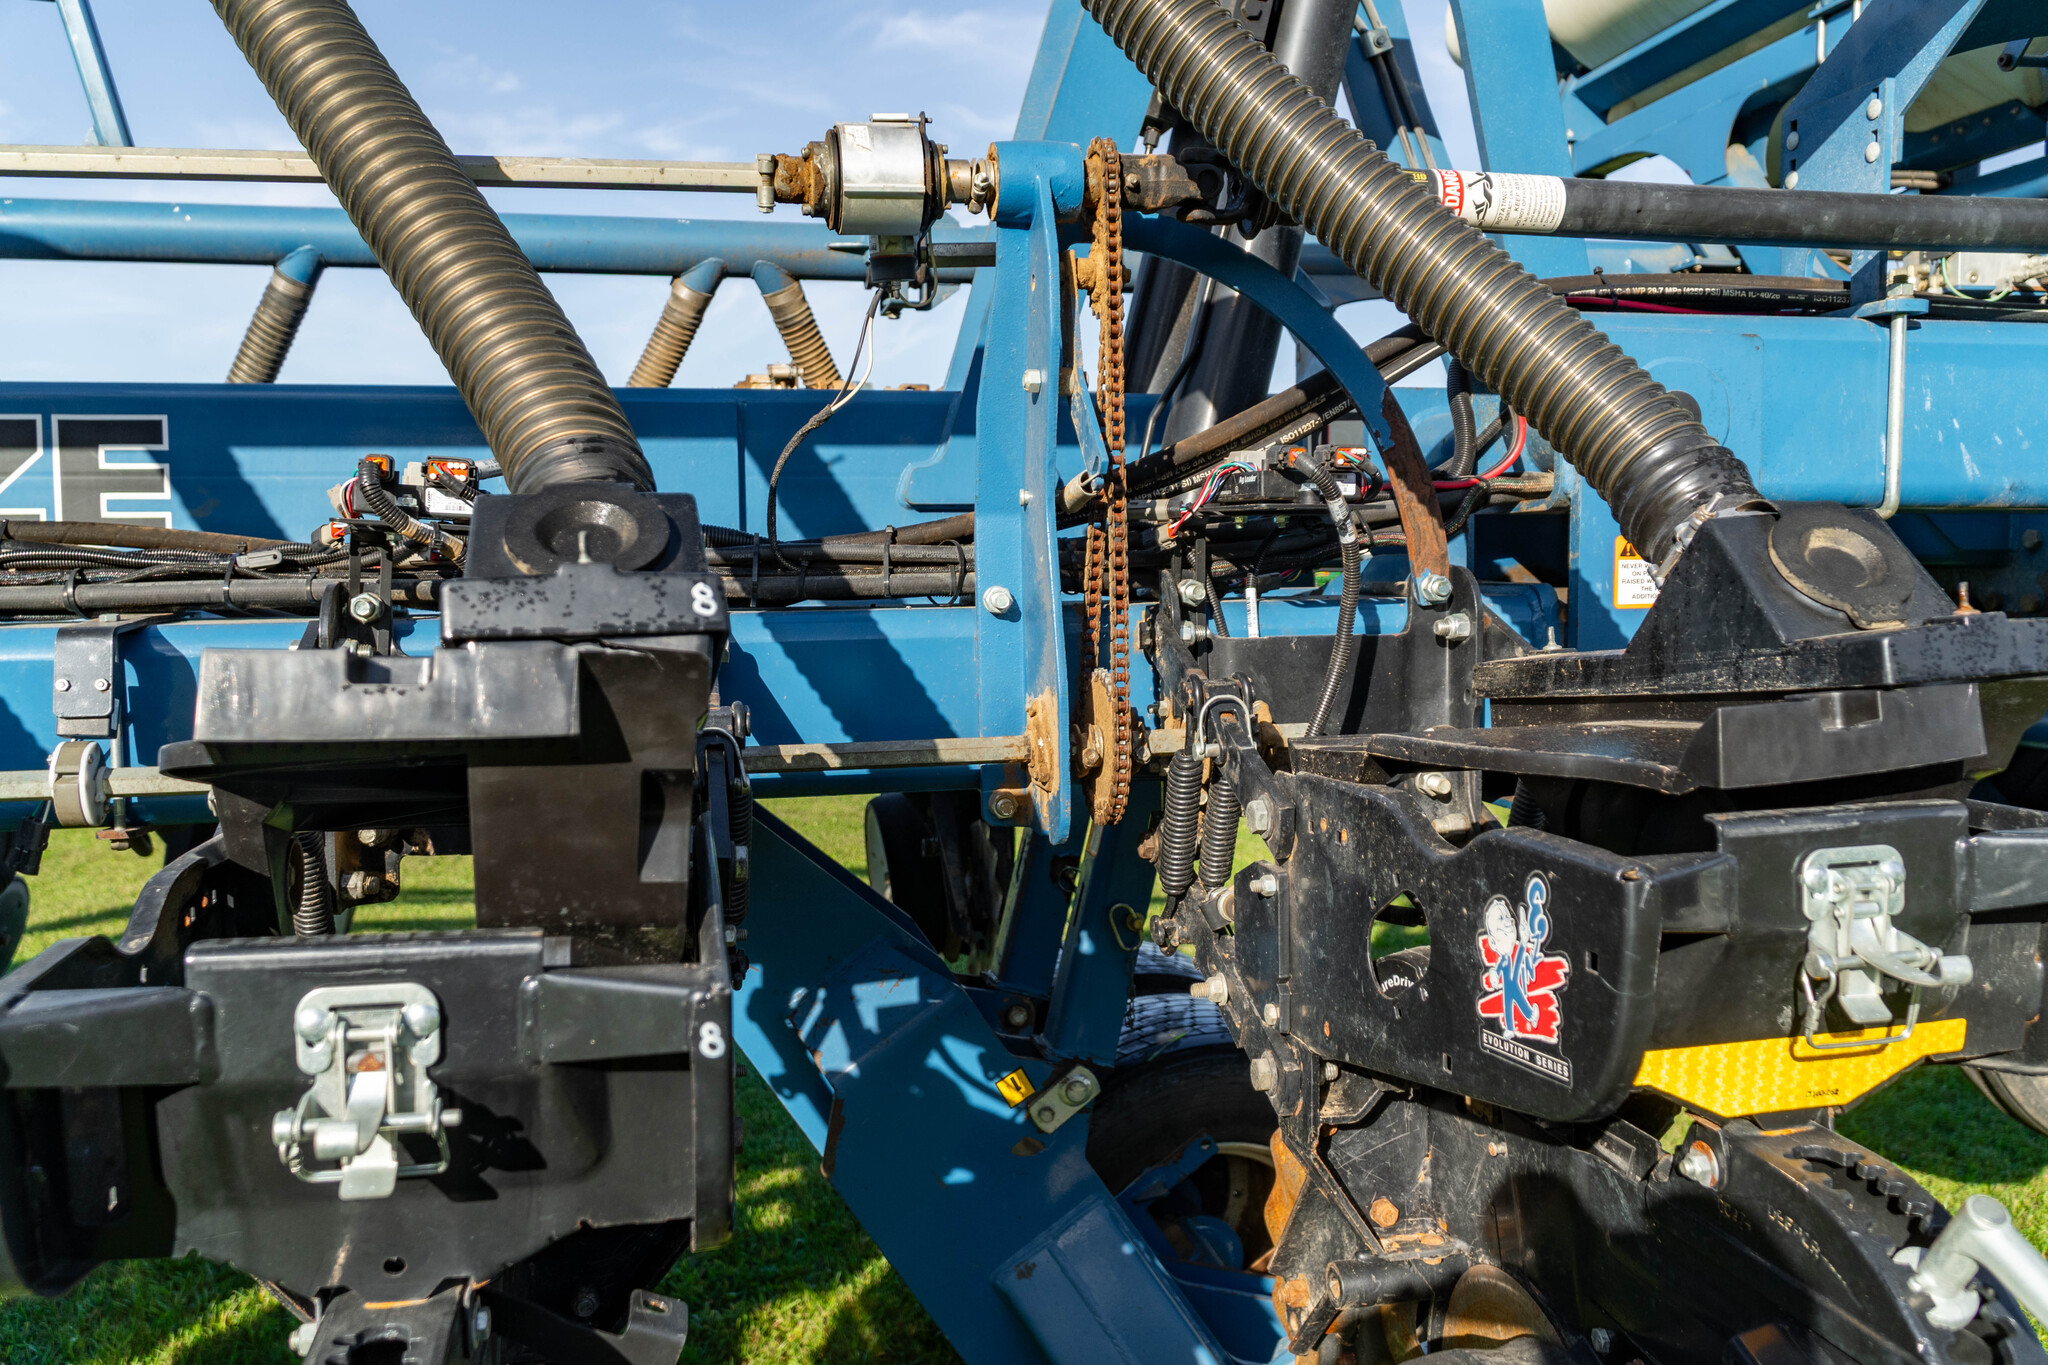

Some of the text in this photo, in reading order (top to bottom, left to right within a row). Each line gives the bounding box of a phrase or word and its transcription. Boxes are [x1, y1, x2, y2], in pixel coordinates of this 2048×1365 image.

[1495, 191, 1507, 225] ROTATING
[1515, 219, 1521, 227] DO
[1632, 287, 1646, 295] WP
[1647, 287, 1664, 295] 29.7
[1665, 287, 1682, 295] MPa
[1722, 289, 1746, 297] MSHA
[691, 581, 718, 617] 8
[698, 1020, 726, 1059] 8
[1483, 1032, 1569, 1077] EVOLUTION SERIES
